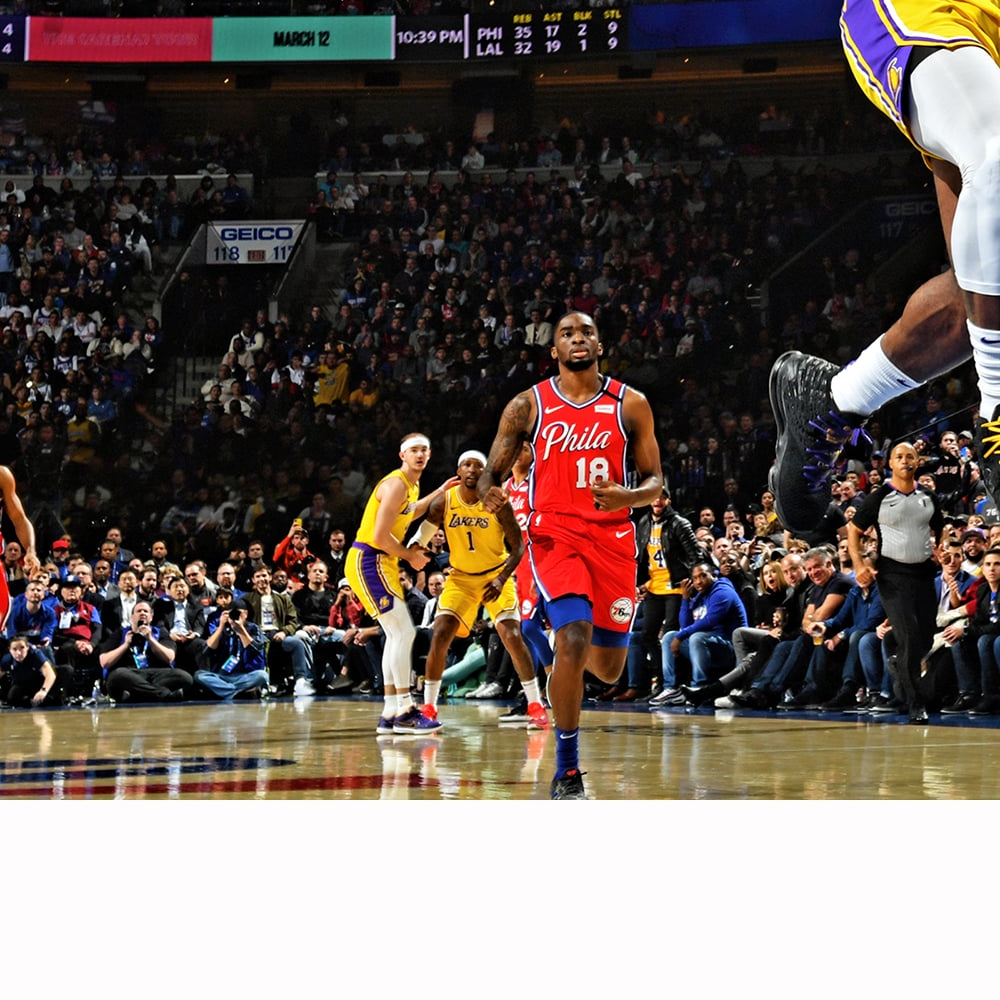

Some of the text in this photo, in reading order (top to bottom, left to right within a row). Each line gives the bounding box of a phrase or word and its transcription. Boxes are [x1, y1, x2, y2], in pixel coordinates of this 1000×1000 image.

[513, 10, 622, 23] REB AST BLK STL
[397, 30, 464, 44] 10:39 PM
[477, 21, 618, 40] PHI 35 17 2 9
[273, 31, 330, 47] MARCH 12
[476, 37, 618, 56] LAL 32 19 1 9
[885, 201, 937, 217] GEIC
[221, 227, 293, 241] GEICO
[214, 246, 240, 261] 118
[541, 421, 612, 461] Phila
[576, 456, 609, 489] 18
[448, 513, 490, 529] LAKERS
[466, 531, 476, 553] 1
